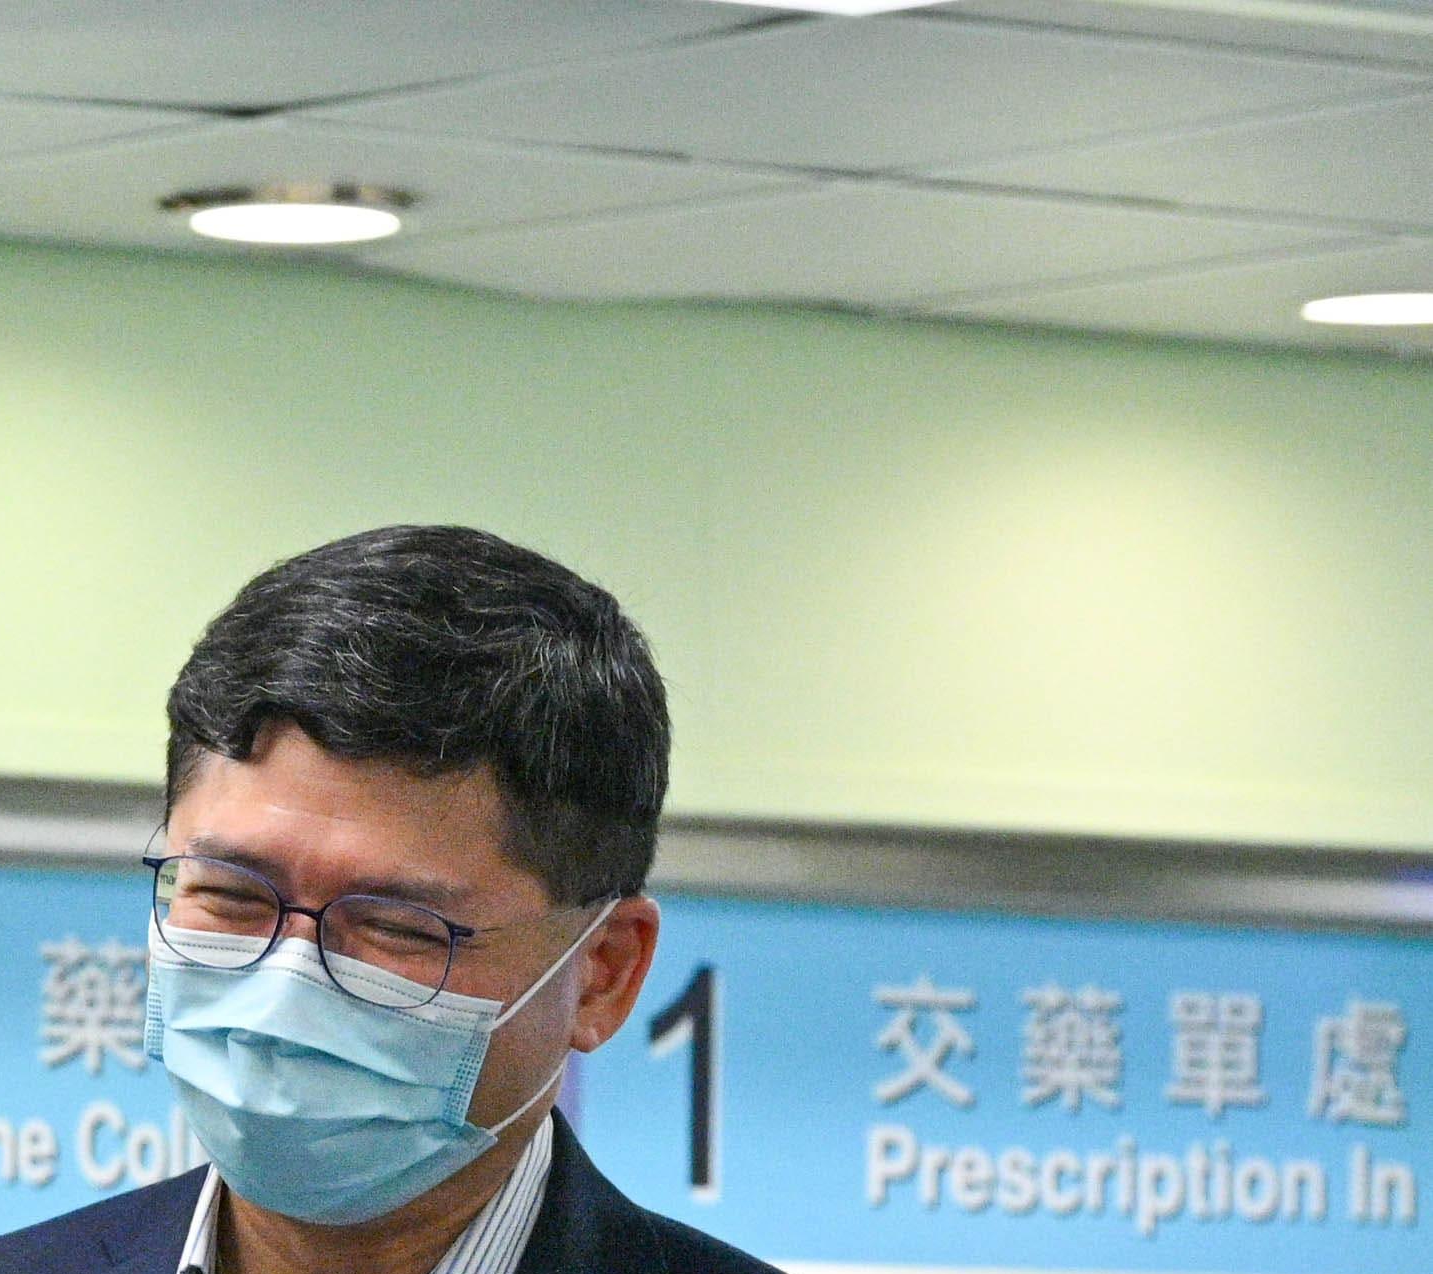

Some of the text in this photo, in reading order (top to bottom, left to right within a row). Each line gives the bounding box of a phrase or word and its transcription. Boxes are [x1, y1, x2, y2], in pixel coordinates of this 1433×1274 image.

[649, 960, 715, 1192] 1
[871, 975, 1409, 1127] 交藥單處
[865, 1123, 1417, 1237] Prescription In
